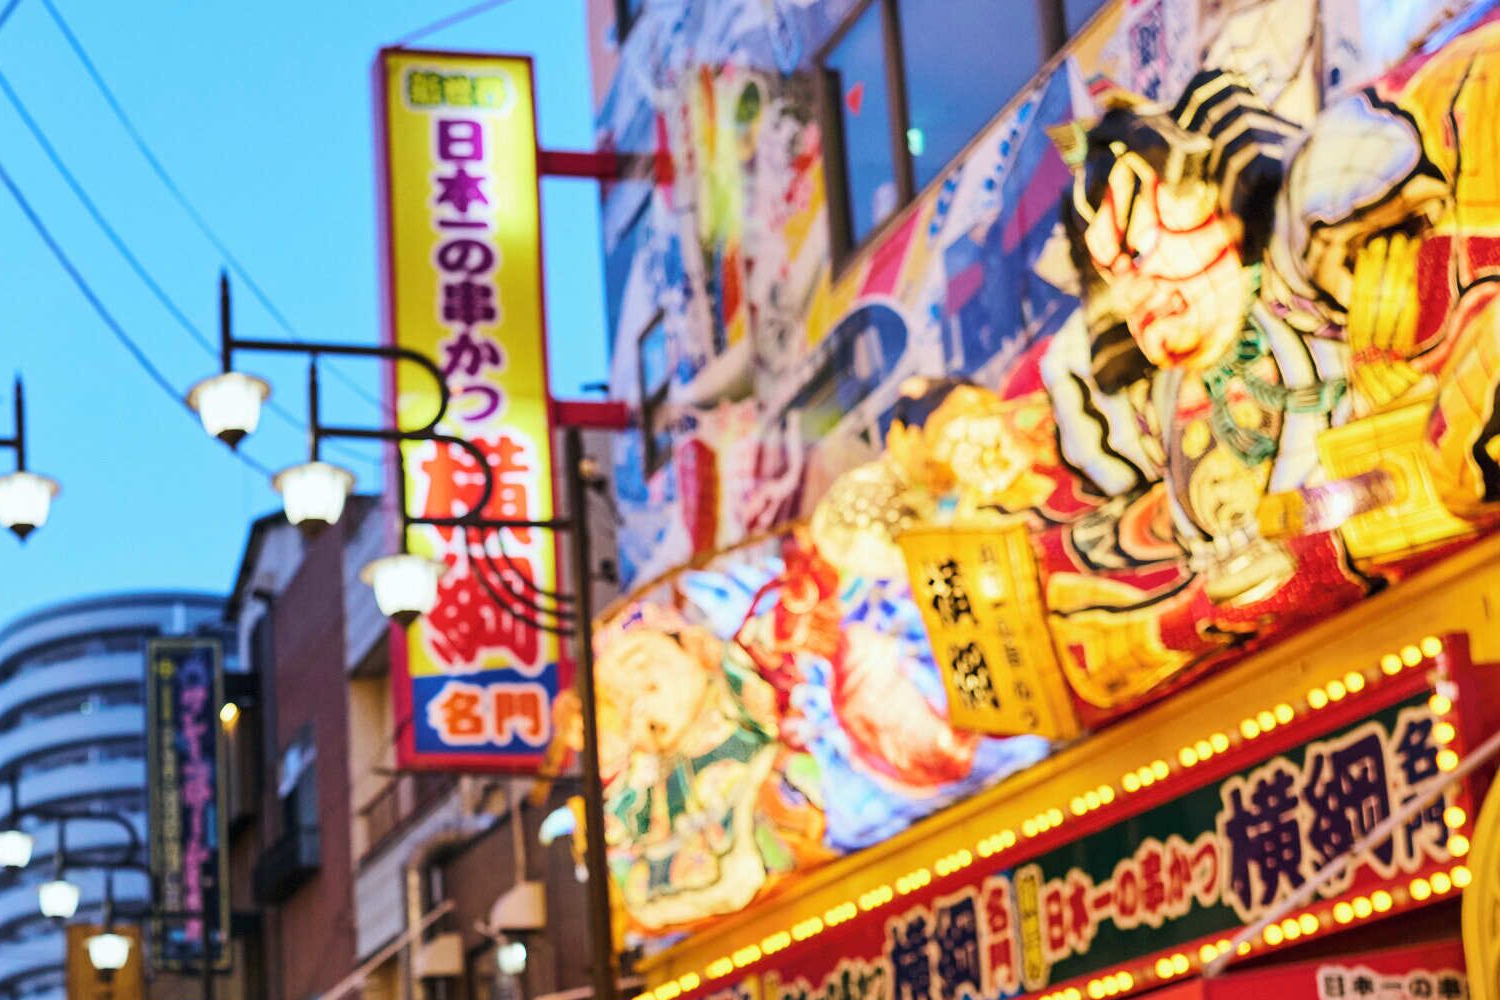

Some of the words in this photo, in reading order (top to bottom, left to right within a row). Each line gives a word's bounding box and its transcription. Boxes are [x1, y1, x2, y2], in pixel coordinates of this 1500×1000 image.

[437, 119, 501, 421] 日本一の串かつ
[442, 690, 543, 738] 名門
[1045, 841, 1218, 953] 日本一の串かつ
[1227, 733, 1395, 910] 横綱
[1323, 974, 1469, 998] 日本一の串
